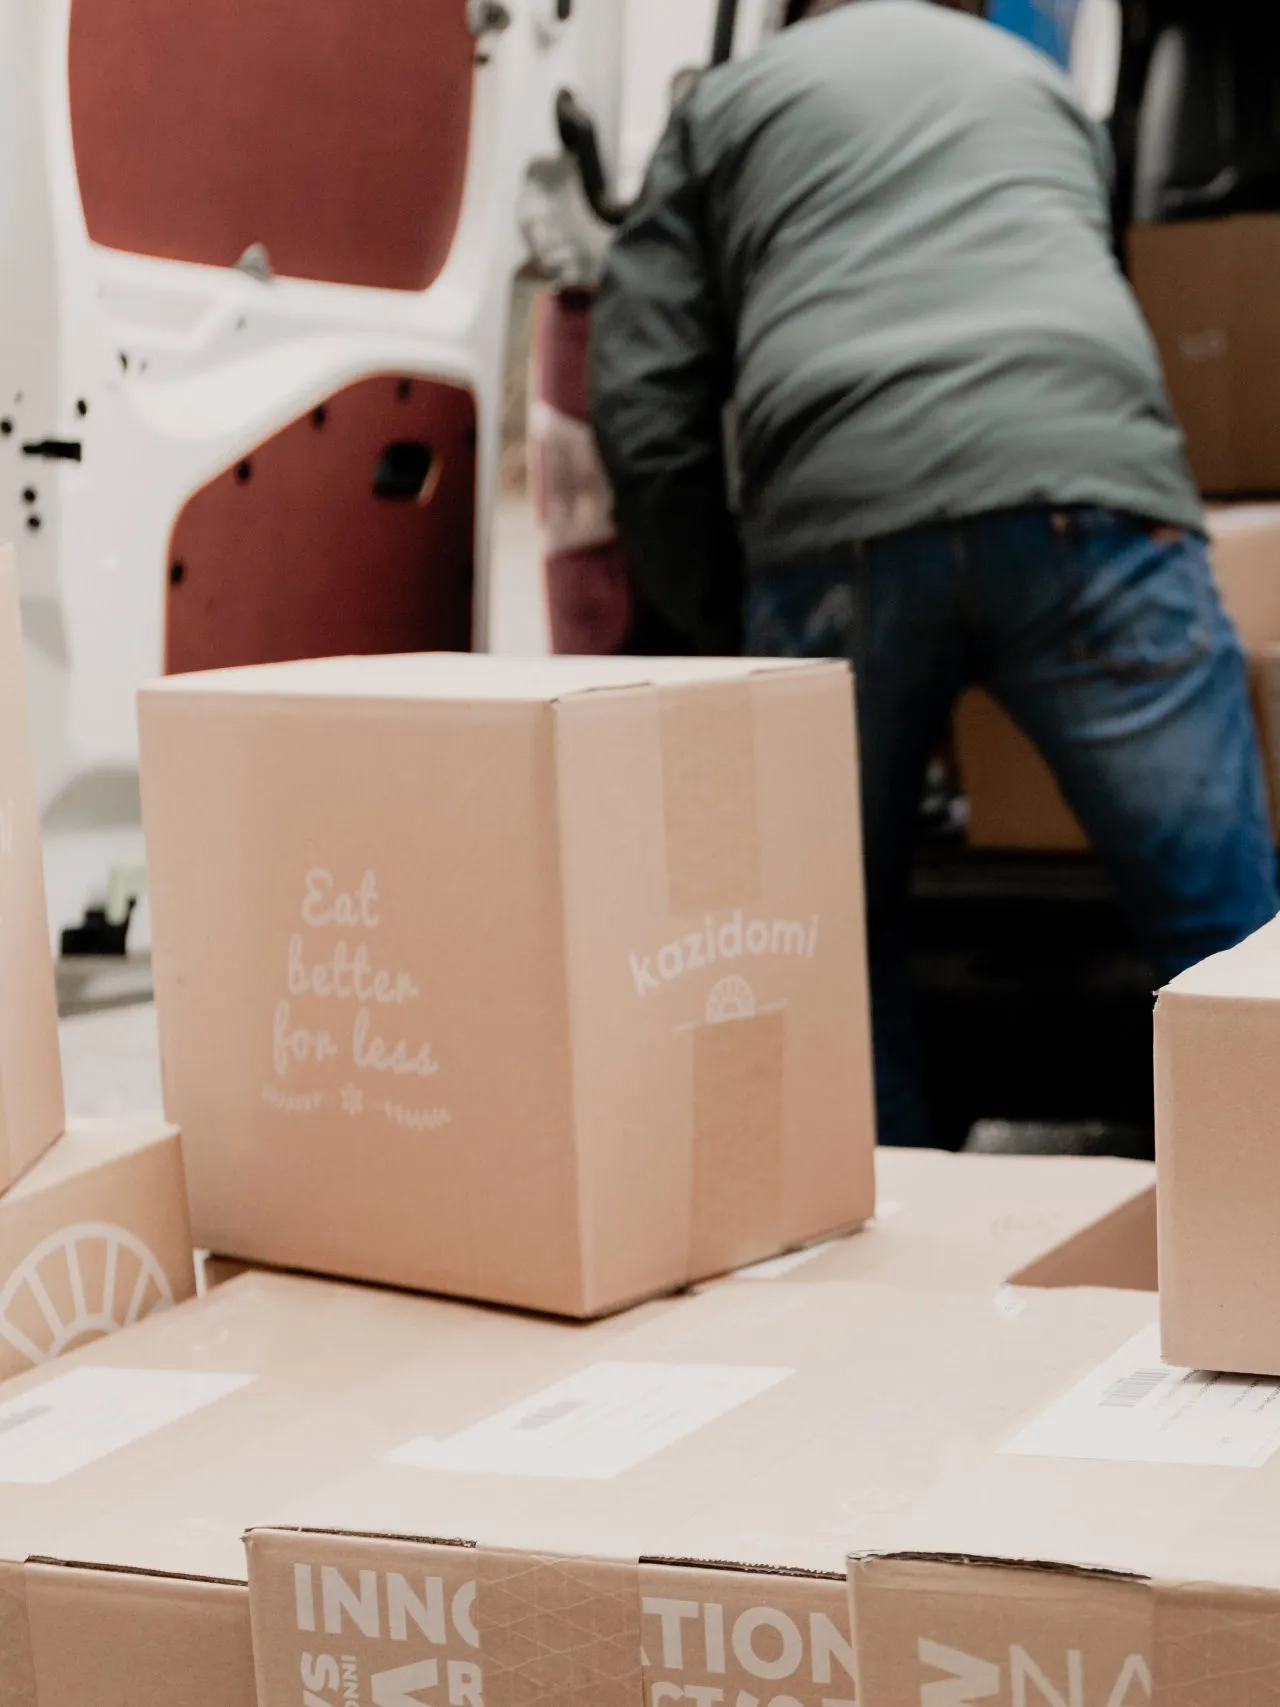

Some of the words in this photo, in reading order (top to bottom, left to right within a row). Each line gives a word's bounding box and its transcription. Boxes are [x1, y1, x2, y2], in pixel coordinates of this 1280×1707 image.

[302, 867, 381, 928] Eat
[286, 932, 420, 1004] better
[627, 908, 820, 998] kazidomi
[272, 997, 339, 1075] for
[352, 1005, 440, 1077] less
